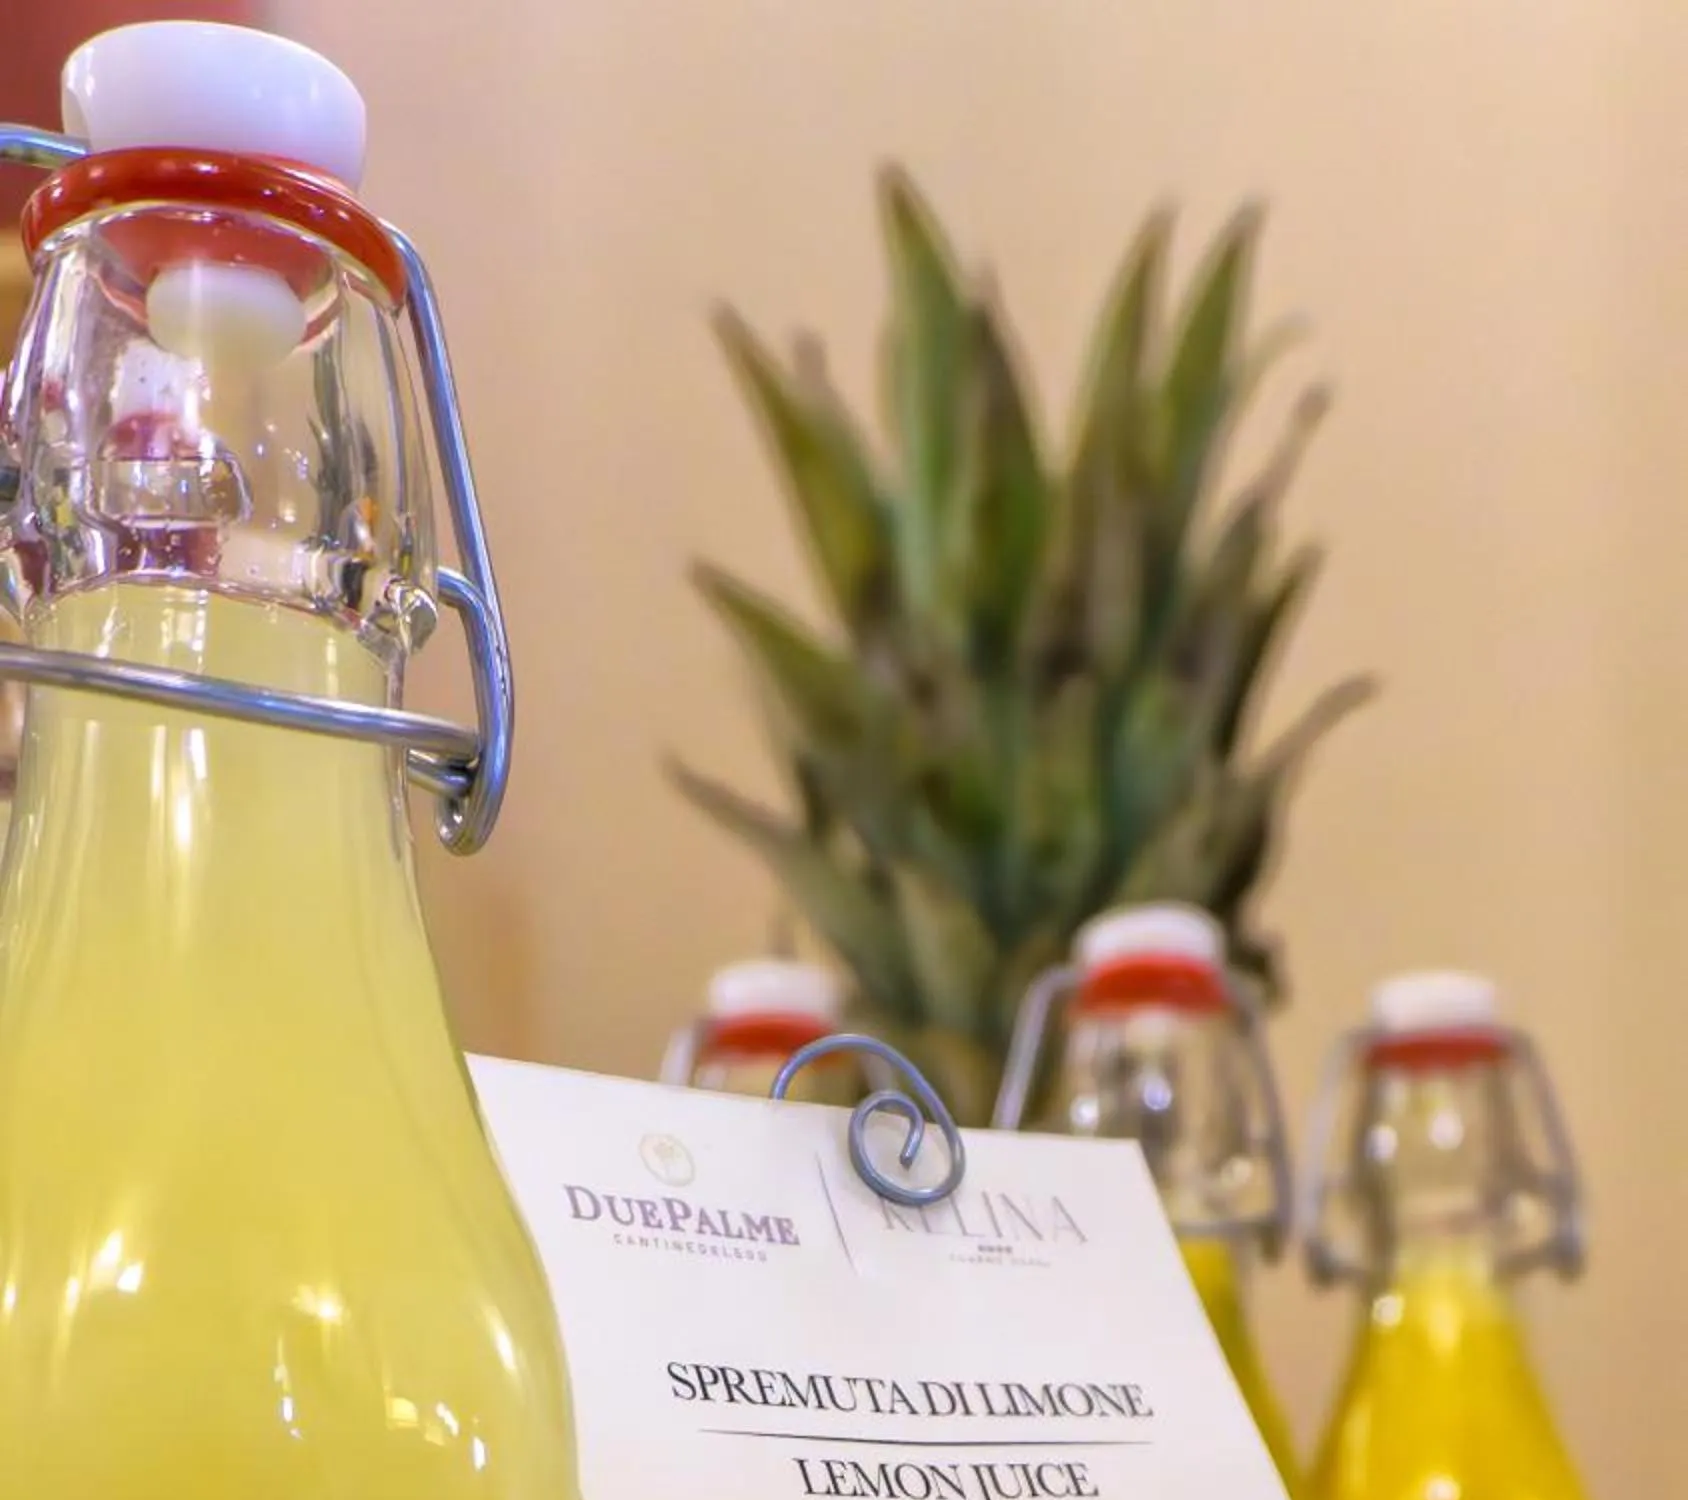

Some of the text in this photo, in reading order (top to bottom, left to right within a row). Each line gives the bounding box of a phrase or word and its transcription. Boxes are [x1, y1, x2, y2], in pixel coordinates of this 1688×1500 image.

[667, 1361, 1154, 1418] SPREMUTA DI LIMONE
[792, 1457, 968, 1500] LEMON
